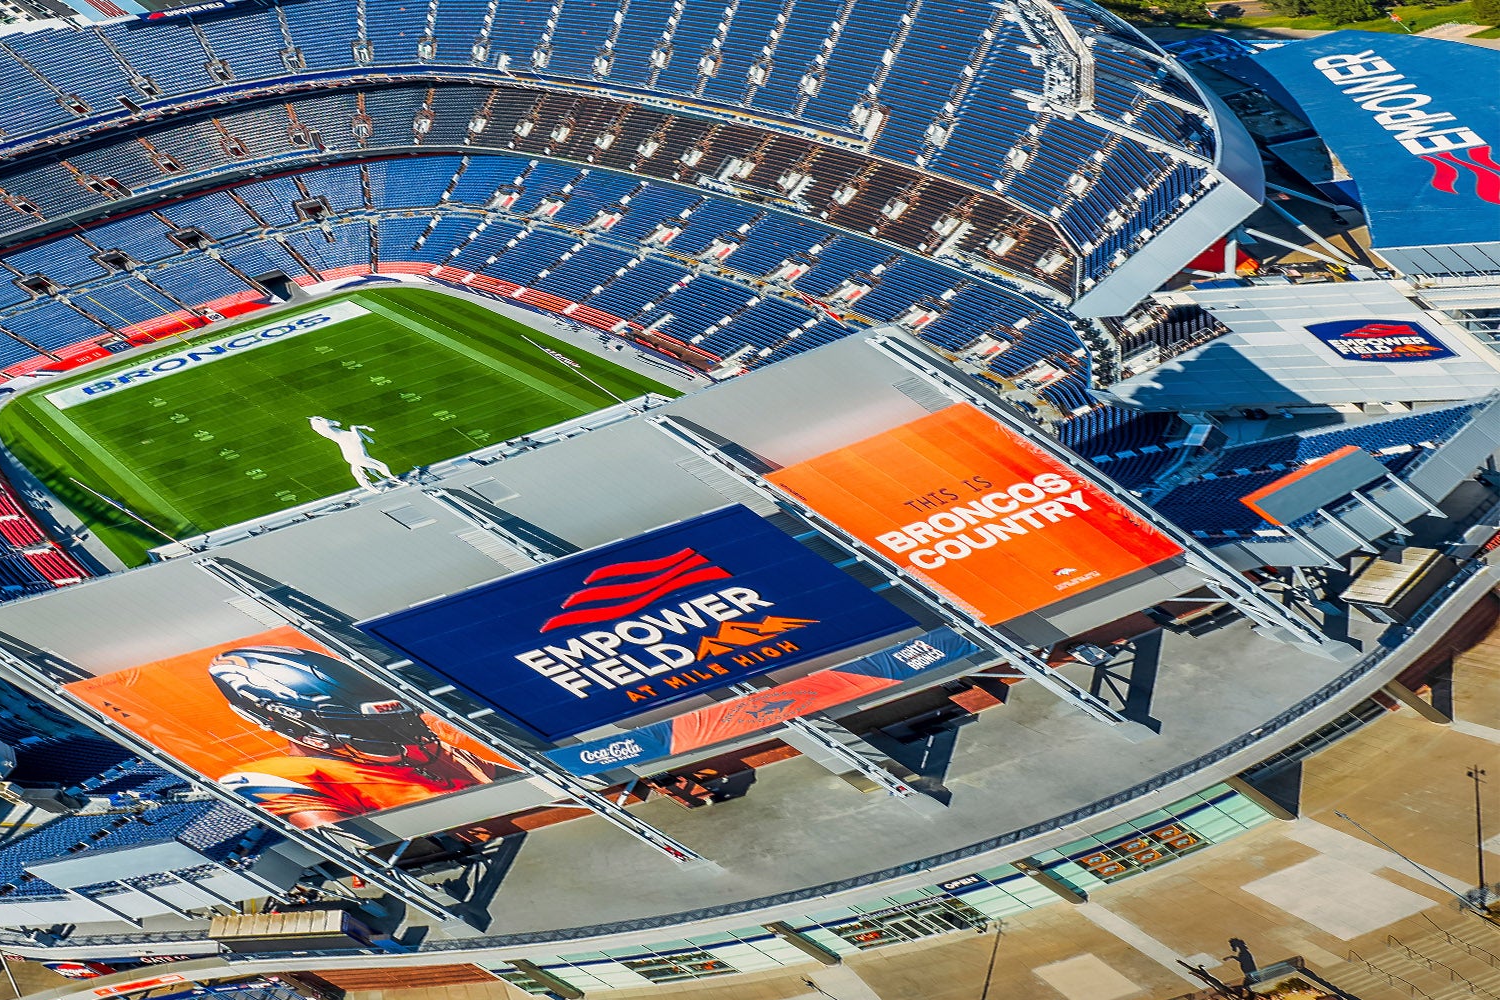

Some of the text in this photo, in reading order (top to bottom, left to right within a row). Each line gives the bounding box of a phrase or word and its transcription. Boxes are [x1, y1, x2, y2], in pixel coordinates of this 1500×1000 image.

[1312, 49, 1488, 155] EMPOWER
[82, 313, 331, 396] BRONCOS
[1327, 336, 1430, 348] EMPOWER
[1338, 345, 1393, 356] FIELD
[875, 472, 1072, 554] BRONCOS
[904, 475, 993, 513] THIS IS
[908, 490, 1093, 570] COUNTRY
[513, 586, 776, 678] EMPOWER
[550, 643, 698, 699] FIELD
[625, 639, 800, 703] AT MILE HIGH
[580, 739, 644, 764] Coca-Cola
[944, 876, 979, 890] OPEN
